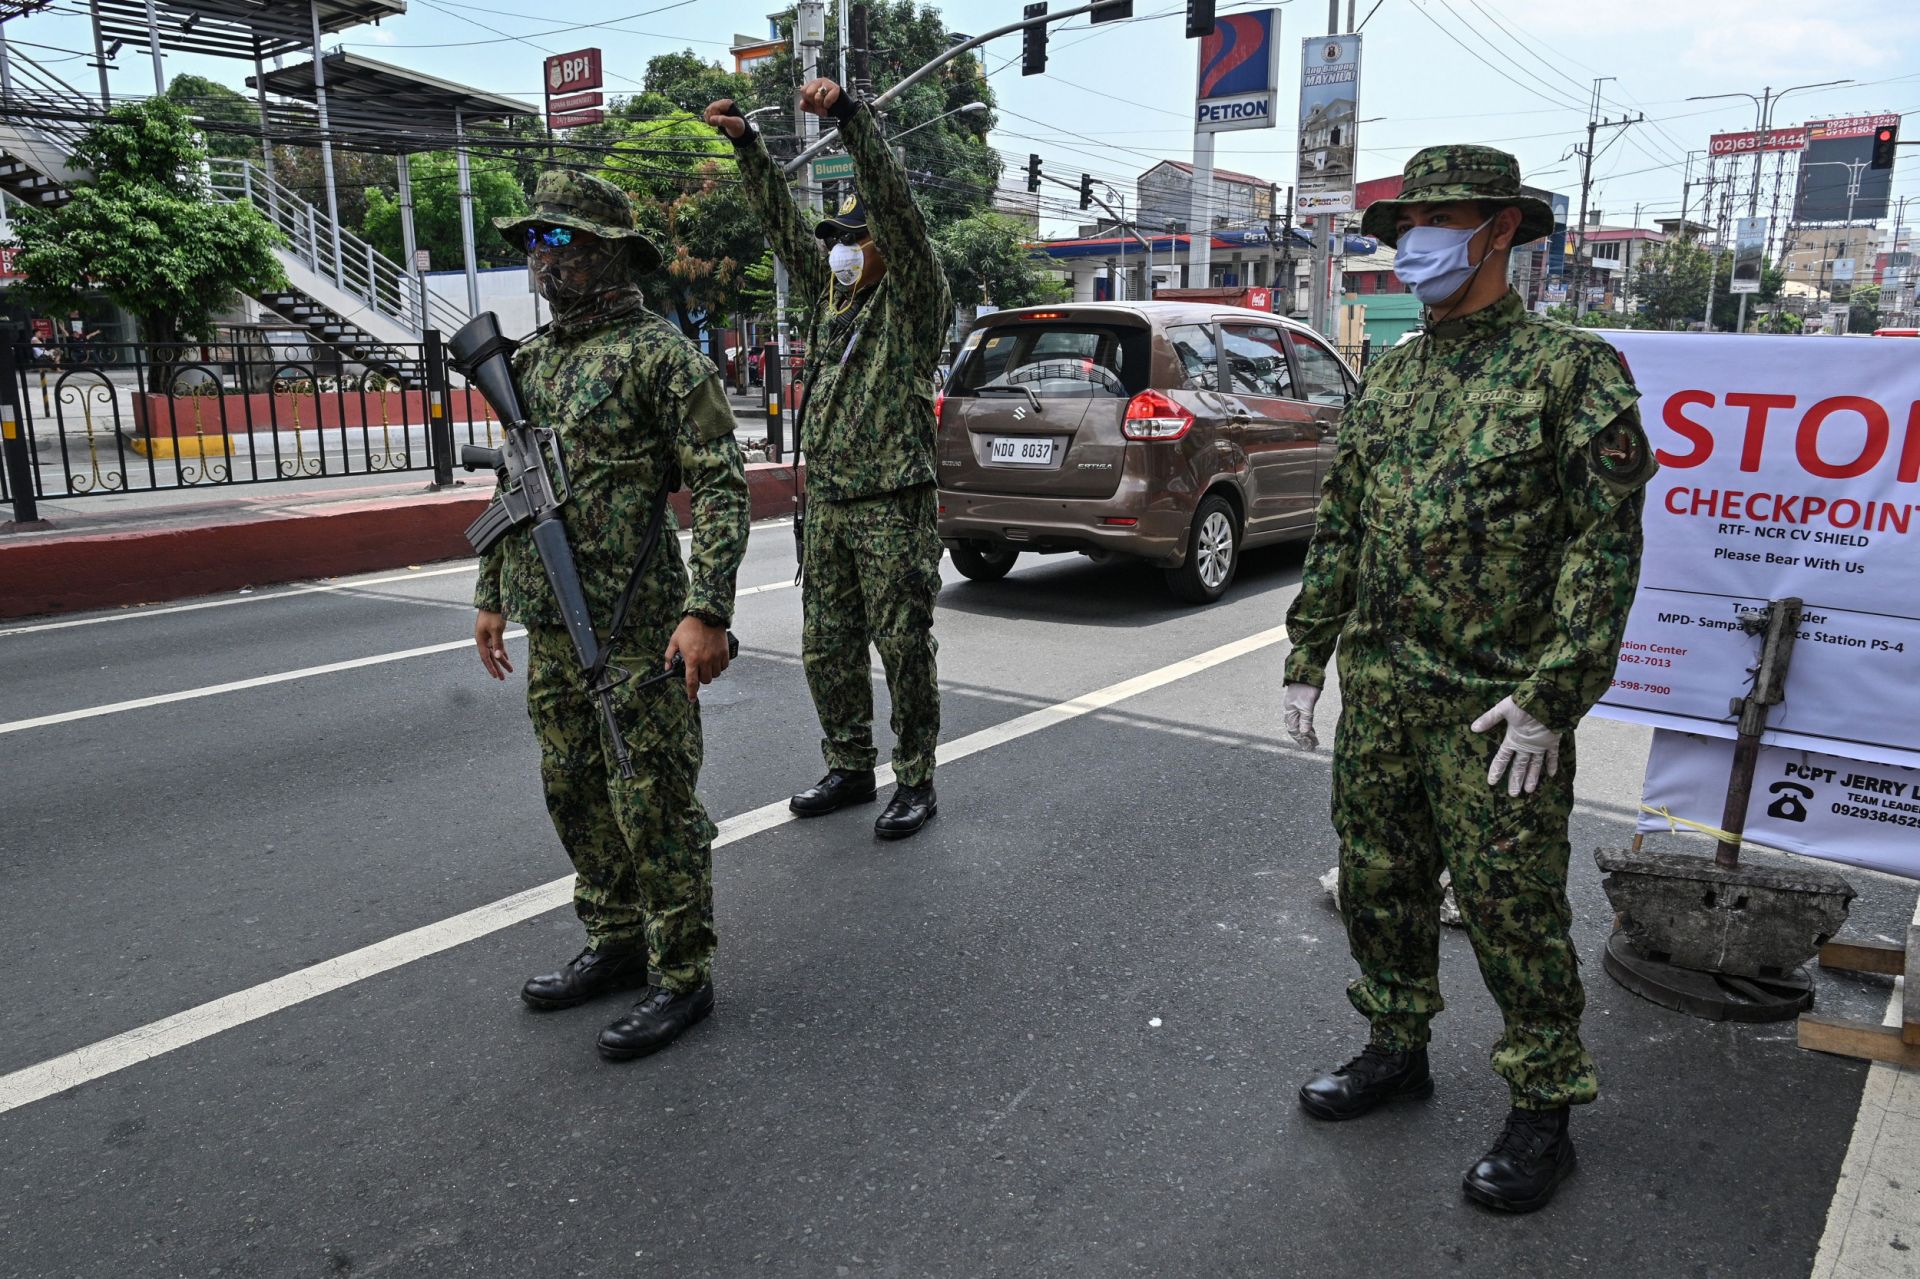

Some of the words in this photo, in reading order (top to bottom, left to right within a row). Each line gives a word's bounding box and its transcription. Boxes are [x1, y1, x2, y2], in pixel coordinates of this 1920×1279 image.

[563, 56, 590, 83] BPI
[1304, 71, 1356, 87] MAYNILA!
[1198, 100, 1268, 122] PETRON
[585, 345, 628, 356] POLICE
[1466, 389, 1538, 403] POLICE
[993, 443, 1015, 457] NDQ
[1021, 443, 1051, 458] 8037
[1718, 523, 1750, 536] RTF-
[1754, 526, 1786, 539] NCR
[1790, 529, 1812, 542] CV
[1814, 531, 1870, 548] SHIELD
[1714, 548, 1761, 563] Please
[1765, 552, 1800, 566] Bear
[1804, 556, 1840, 571] With
[1845, 561, 1865, 574] Us
[1658, 612, 1695, 625] MPD-
[1814, 631, 1867, 649] Station
[1871, 640, 1905, 653] PS-4
[1650, 644, 1688, 656] Center
[1784, 762, 1837, 784] PCPT
[1839, 773, 1909, 797] JERRY
[1847, 792, 1879, 806] TEAM
